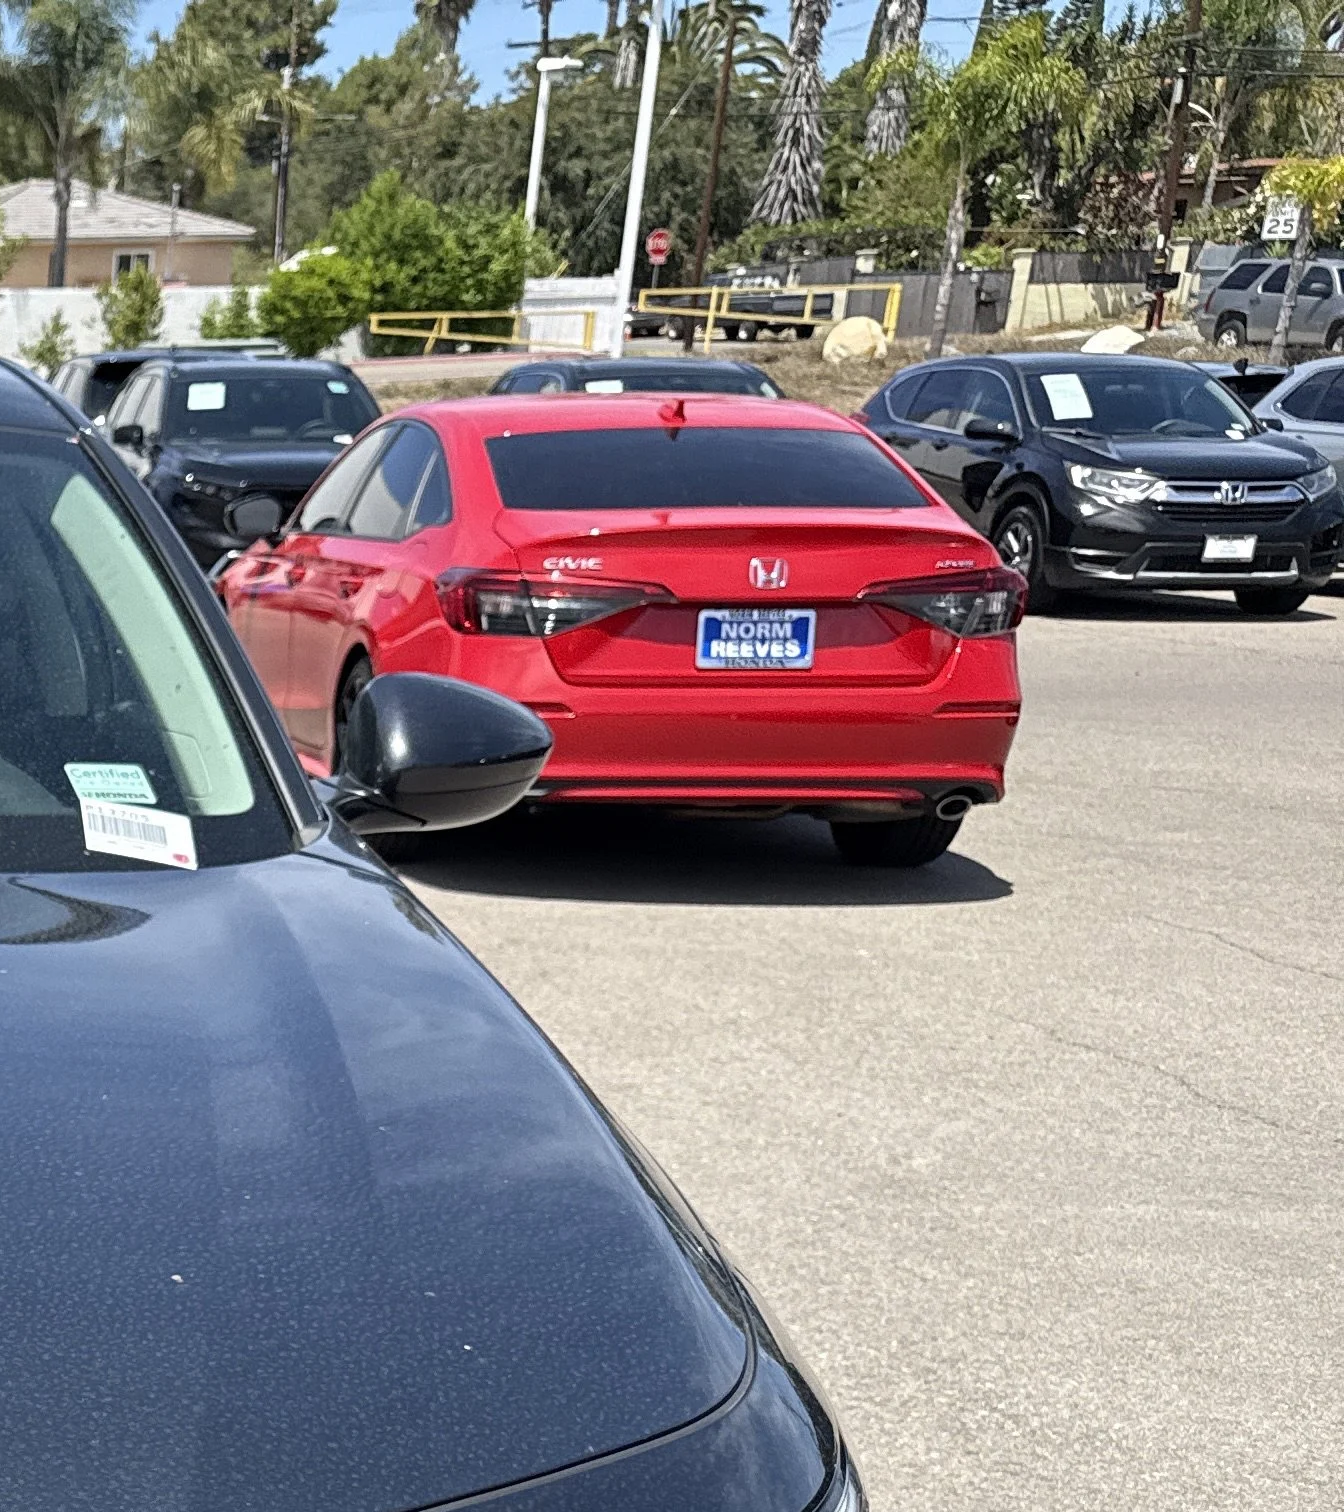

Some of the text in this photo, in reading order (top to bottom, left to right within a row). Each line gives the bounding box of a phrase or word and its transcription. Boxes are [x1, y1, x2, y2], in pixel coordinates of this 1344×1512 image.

[1267, 218, 1295, 234] 25
[543, 556, 604, 570] CIVIC
[720, 622, 793, 640] NORM
[710, 639, 801, 658] REEVES
[70, 768, 141, 780] Certified
